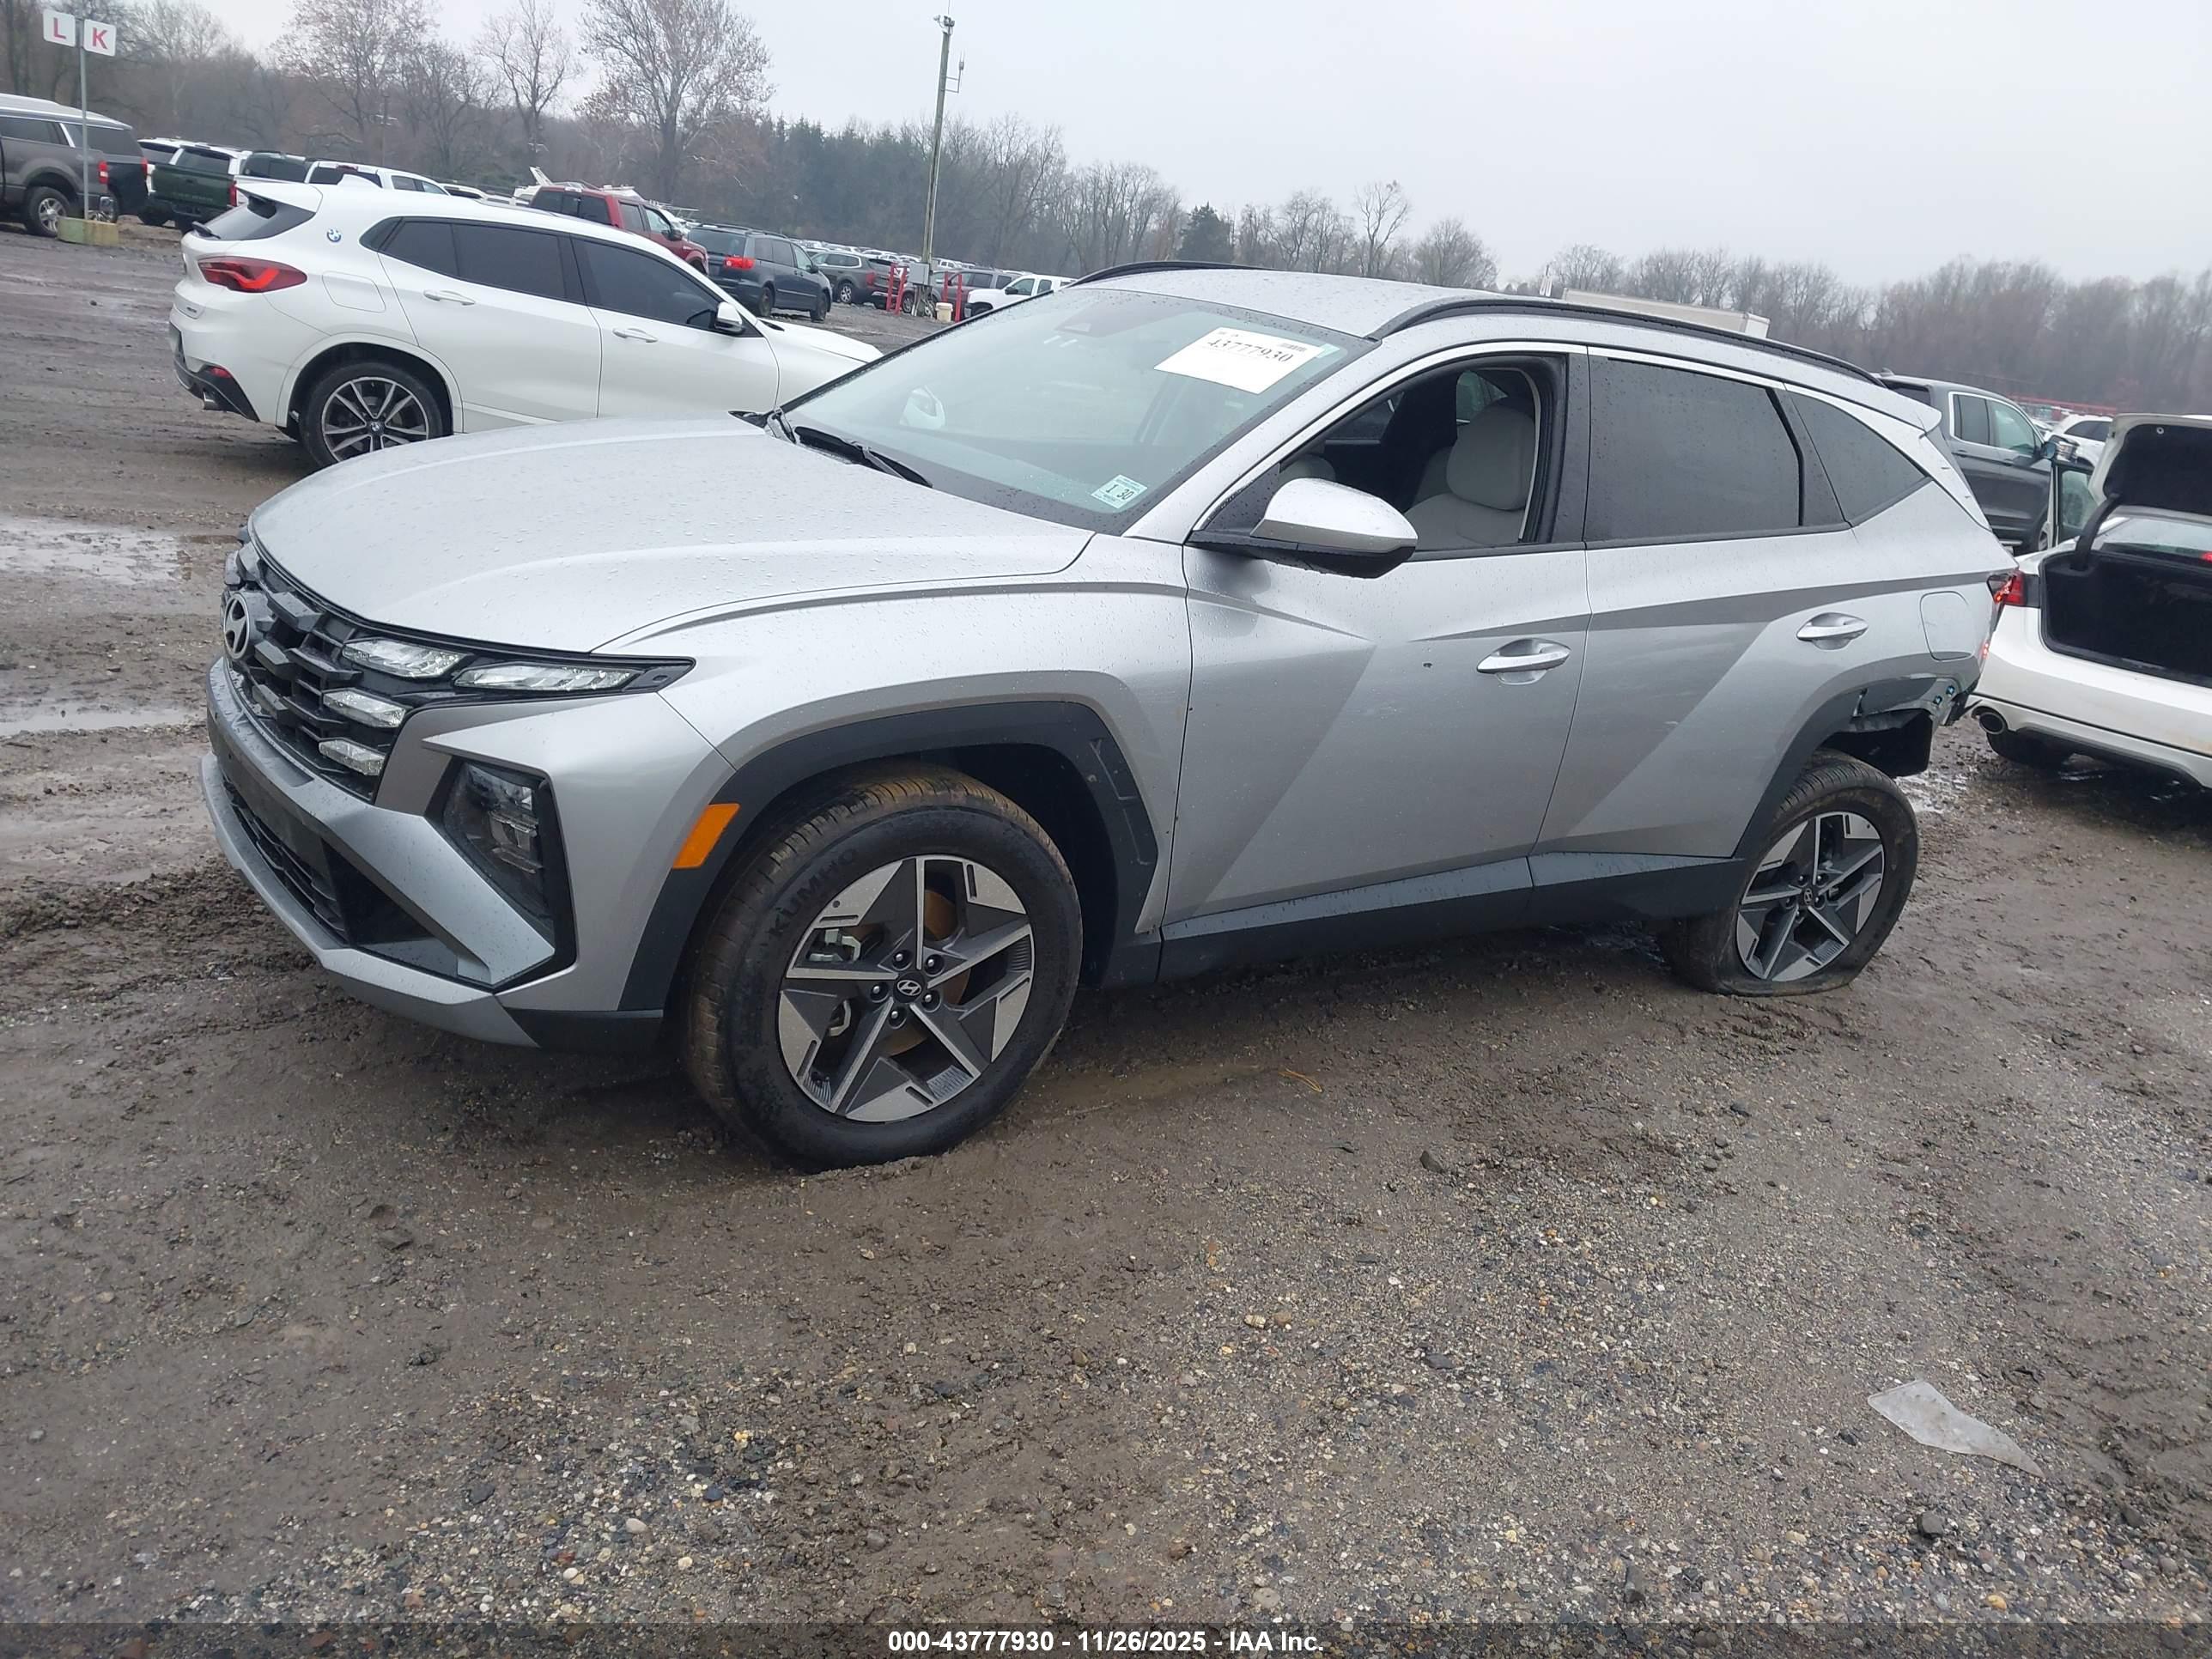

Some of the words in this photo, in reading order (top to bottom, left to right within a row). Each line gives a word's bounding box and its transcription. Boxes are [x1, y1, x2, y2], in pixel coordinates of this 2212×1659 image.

[53, 17, 66, 40] L
[92, 27, 108, 50] K
[1207, 338, 1294, 362] 43777930
